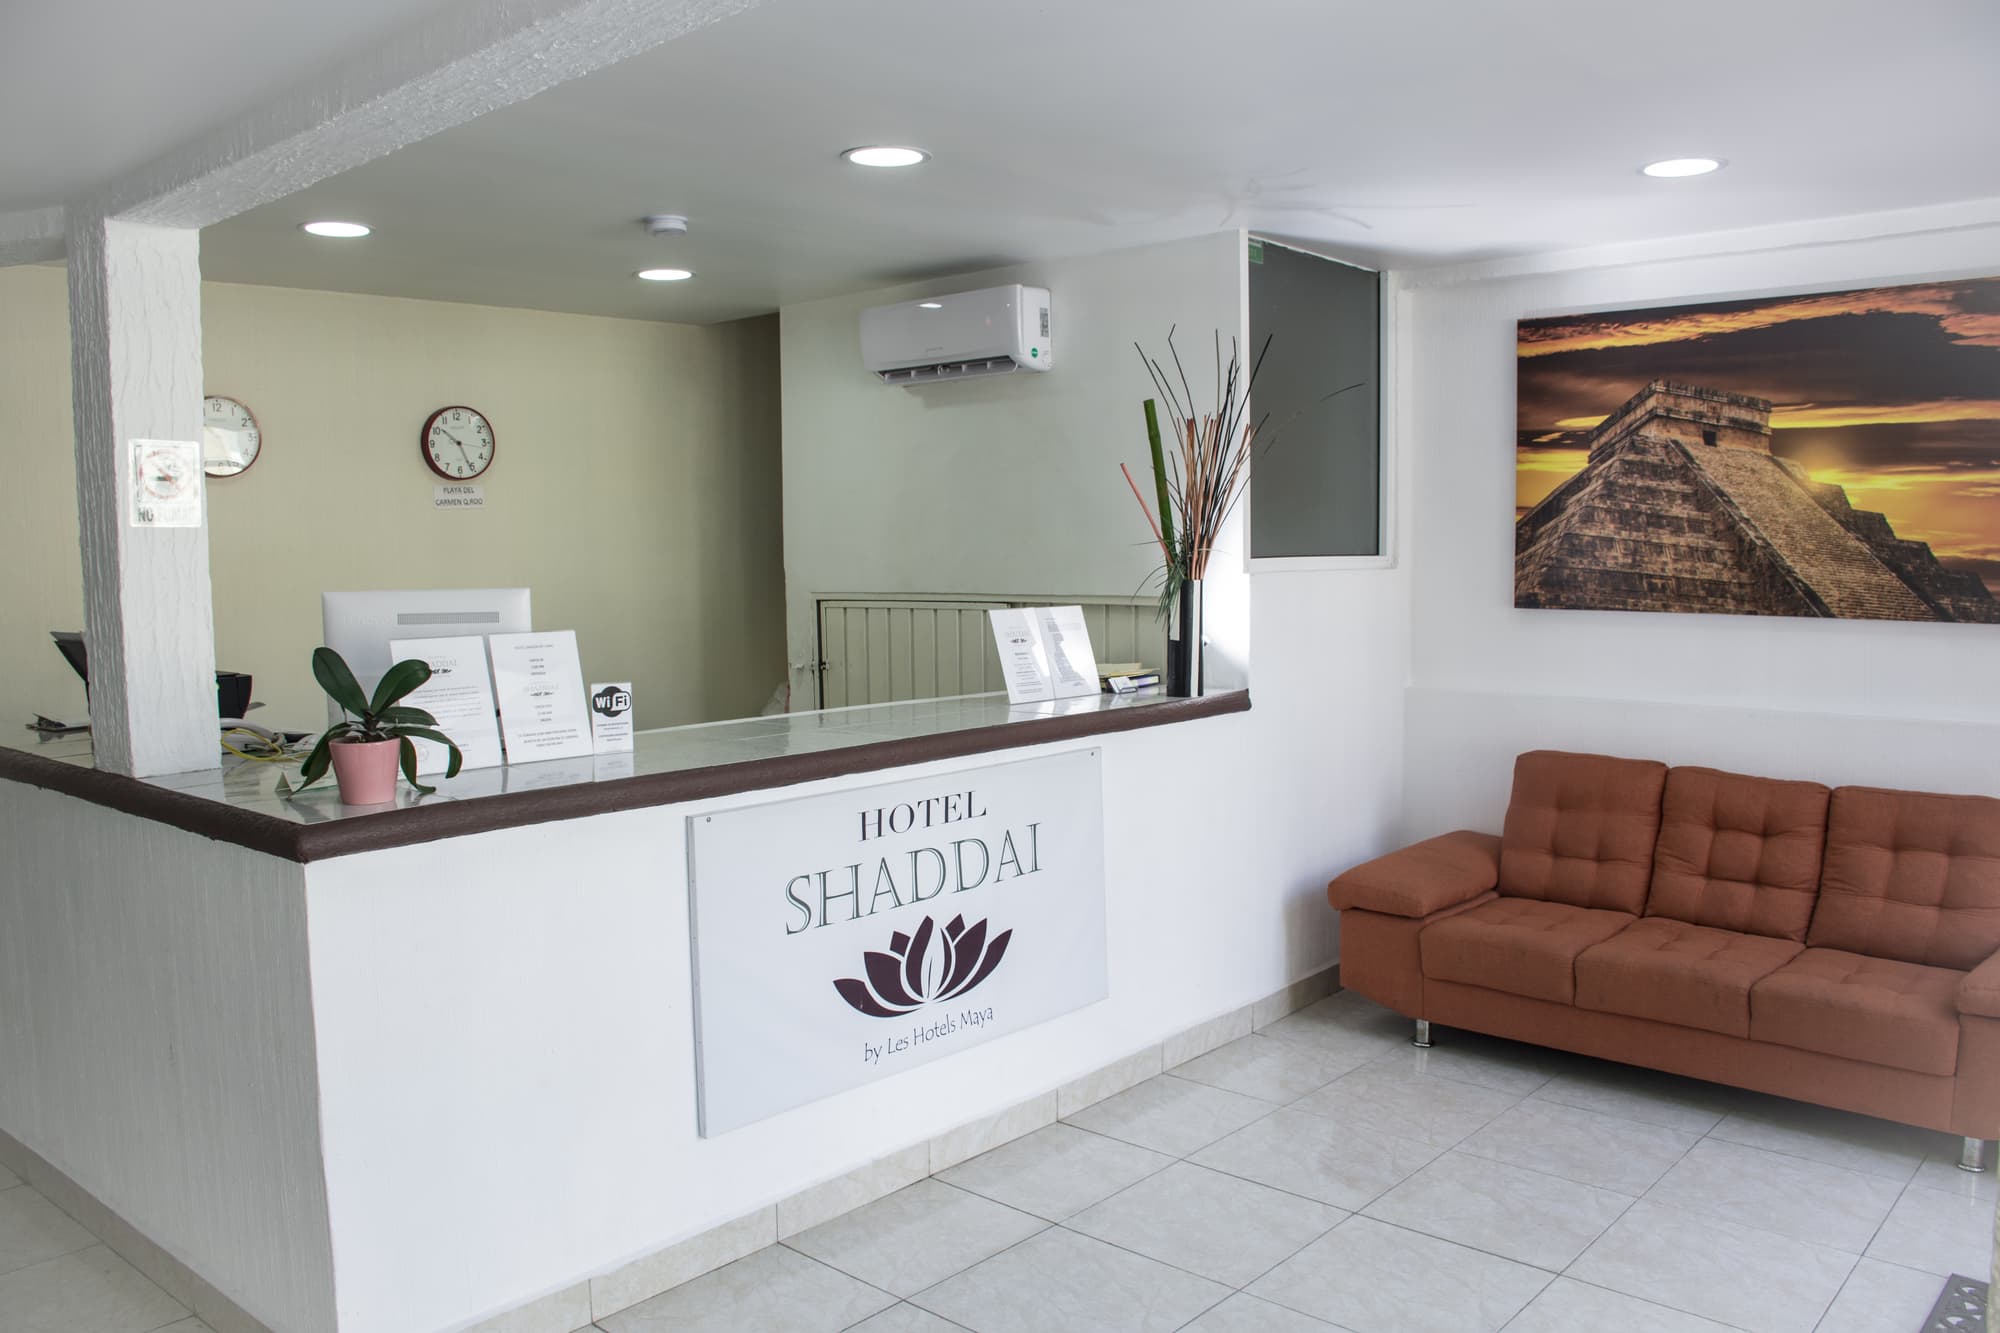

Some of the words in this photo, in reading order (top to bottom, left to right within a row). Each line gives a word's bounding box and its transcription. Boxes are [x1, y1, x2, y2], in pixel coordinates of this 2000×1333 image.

[213, 402, 222, 412] 12
[442, 416, 448, 424] 11
[452, 412, 460, 421] 12
[241, 418, 248, 427] 2
[433, 427, 441, 435] 10
[476, 426, 482, 434] 2
[248, 432, 254, 442] 3
[430, 440, 435, 448] 9
[482, 439, 487, 447] 3
[434, 454, 440, 462] 8
[478, 452, 484, 460] 4
[444, 463, 450, 471] 7
[457, 466, 463, 474] 6
[138, 507, 154, 522] NO
[857, 790, 987, 842] HOTEL
[785, 822, 1043, 935] SHADDAI
[864, 1043, 883, 1064] by
[887, 1034, 910, 1056] Les
[913, 1015, 957, 1046] Hotels
[960, 1006, 993, 1029] Maya
